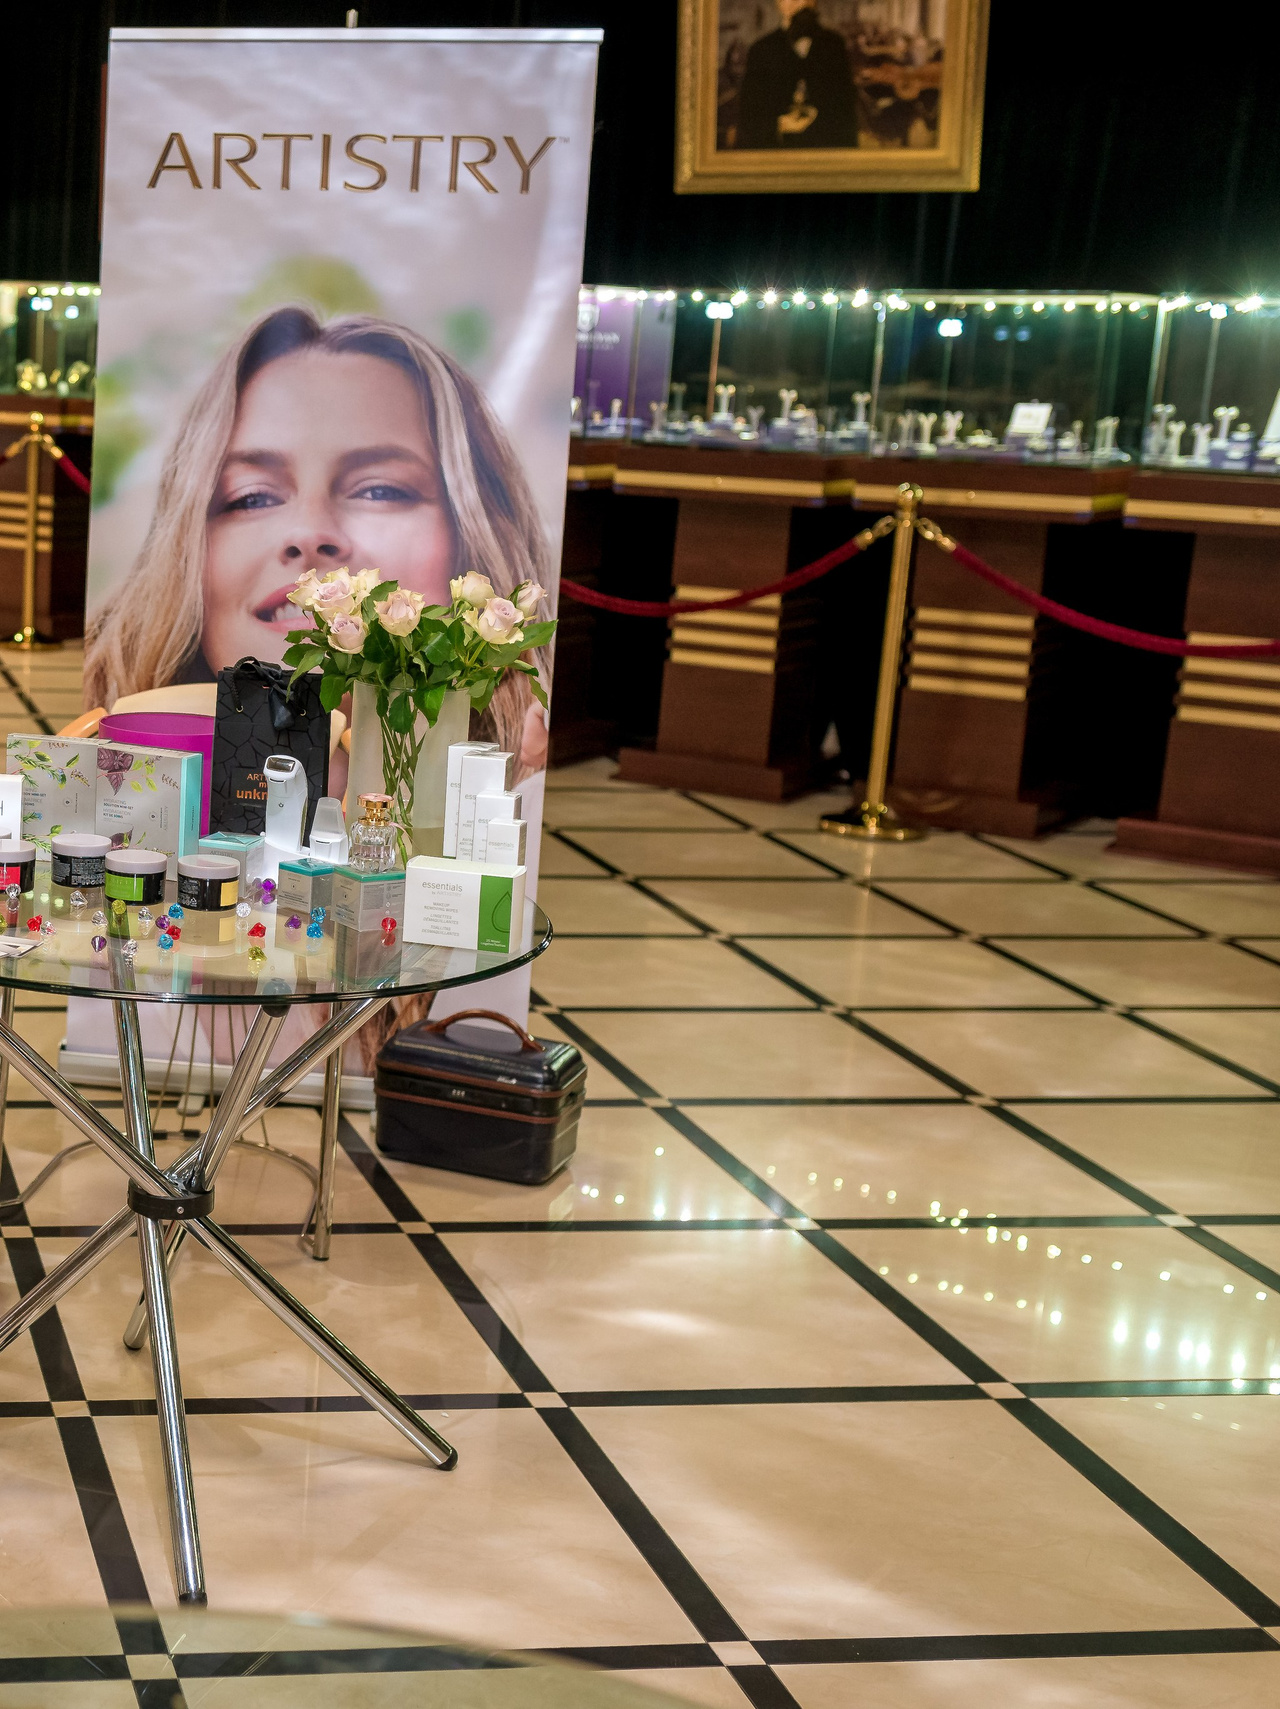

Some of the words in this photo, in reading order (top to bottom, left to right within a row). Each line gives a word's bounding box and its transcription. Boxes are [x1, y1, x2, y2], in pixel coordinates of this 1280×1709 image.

[147, 132, 557, 195] ARTISTRY
[246, 773, 268, 781] ARTI
[236, 788, 269, 800] unkn
[422, 881, 463, 892] essentials
